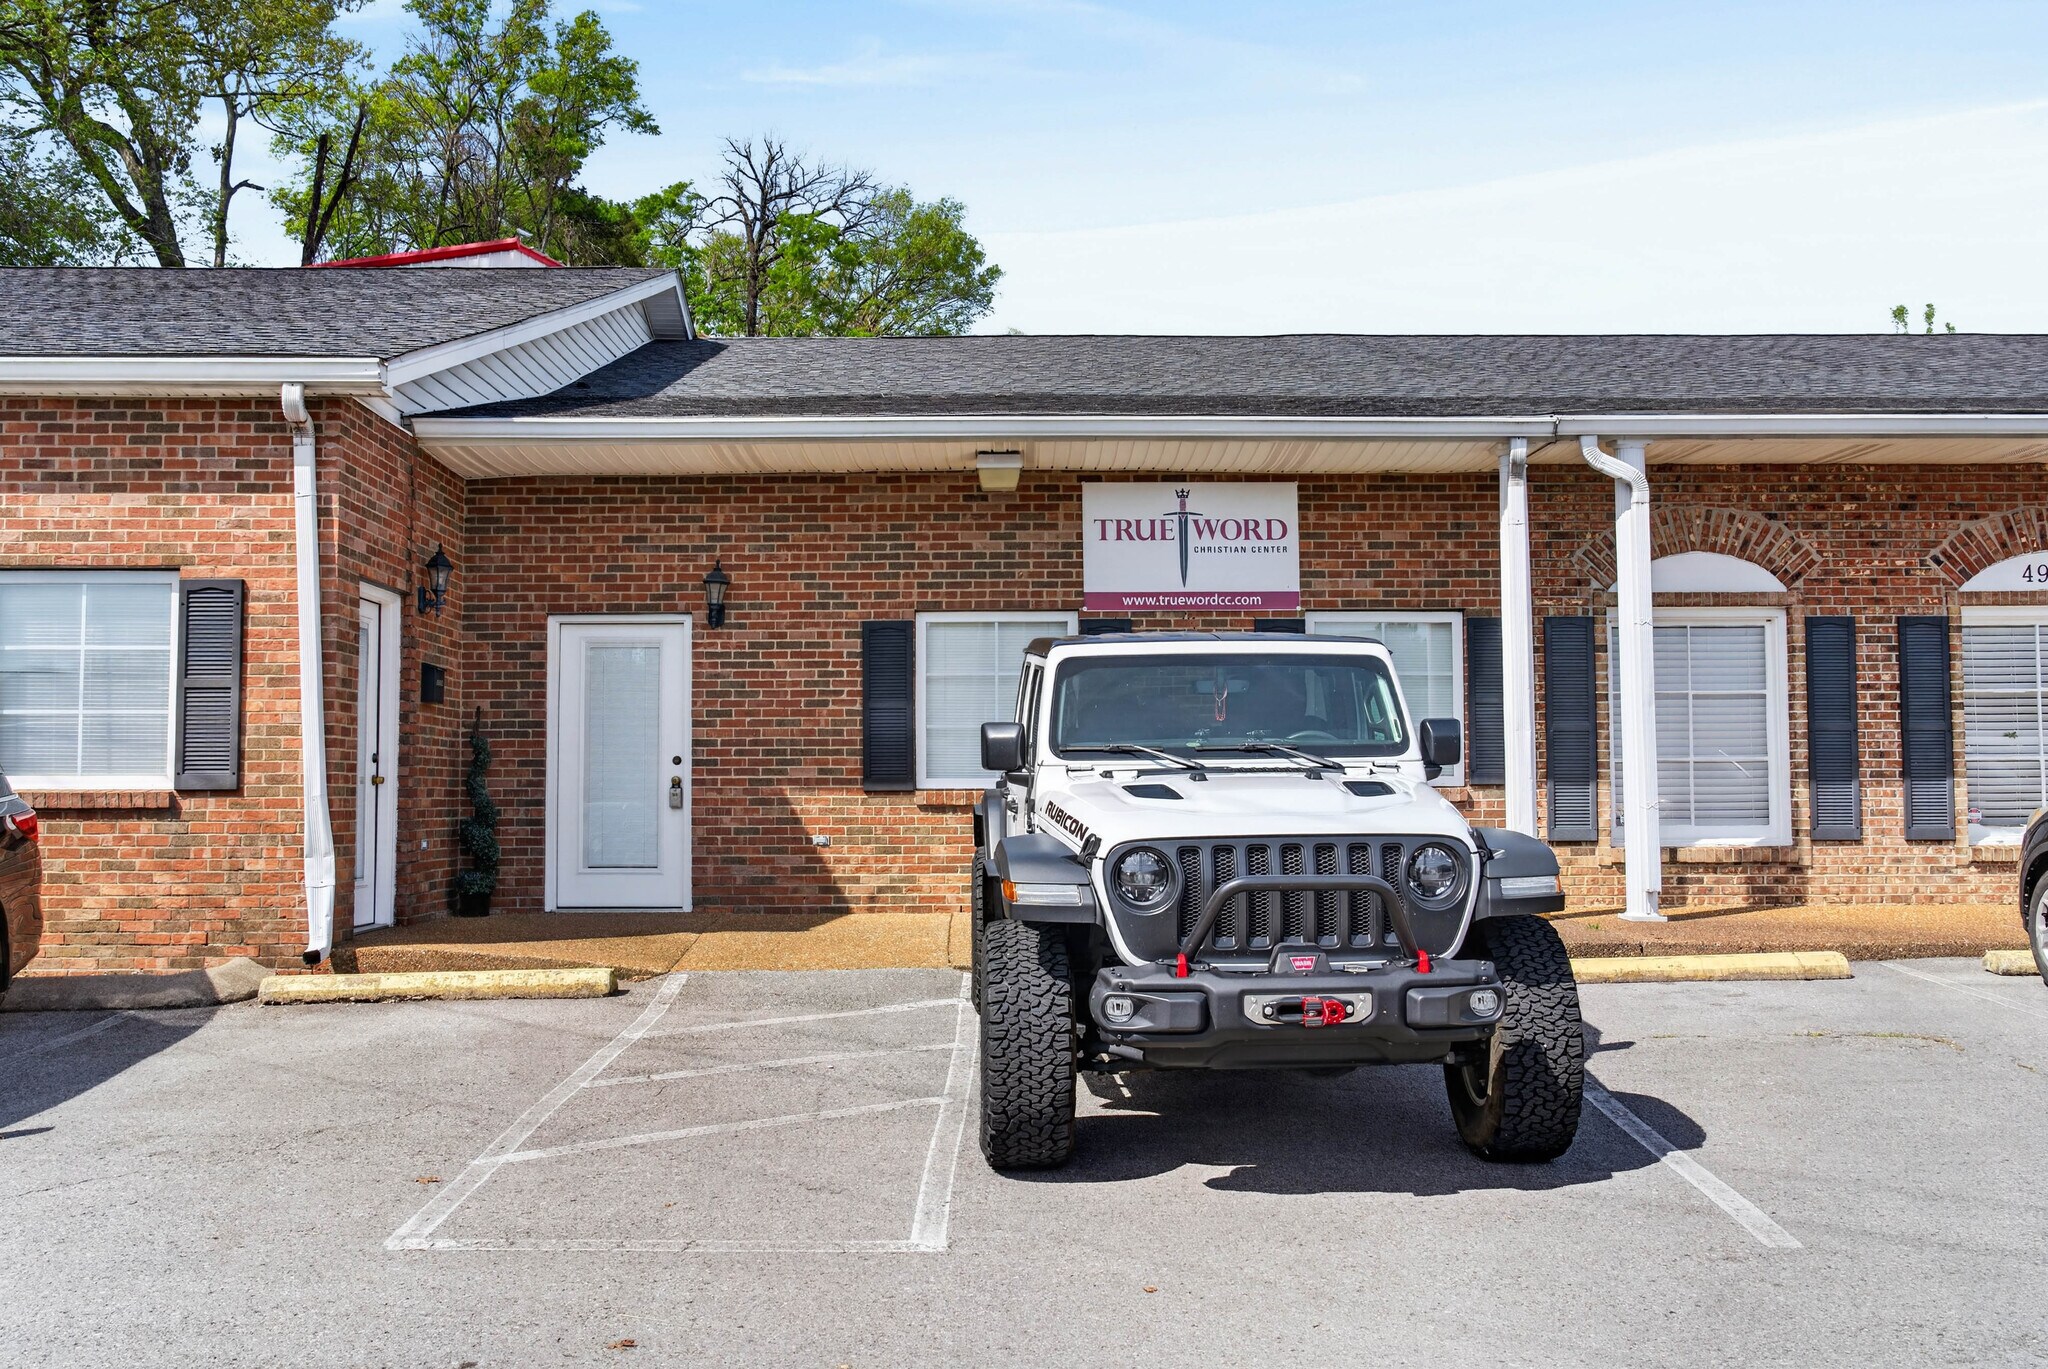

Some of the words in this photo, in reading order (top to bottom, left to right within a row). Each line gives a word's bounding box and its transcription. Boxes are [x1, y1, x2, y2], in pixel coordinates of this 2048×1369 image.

[1093, 518, 1175, 541] TRUE
[1191, 518, 1288, 541] WORD
[1122, 593, 1262, 606] www.truewordcc.com
[1044, 800, 1089, 842] RUBICON
